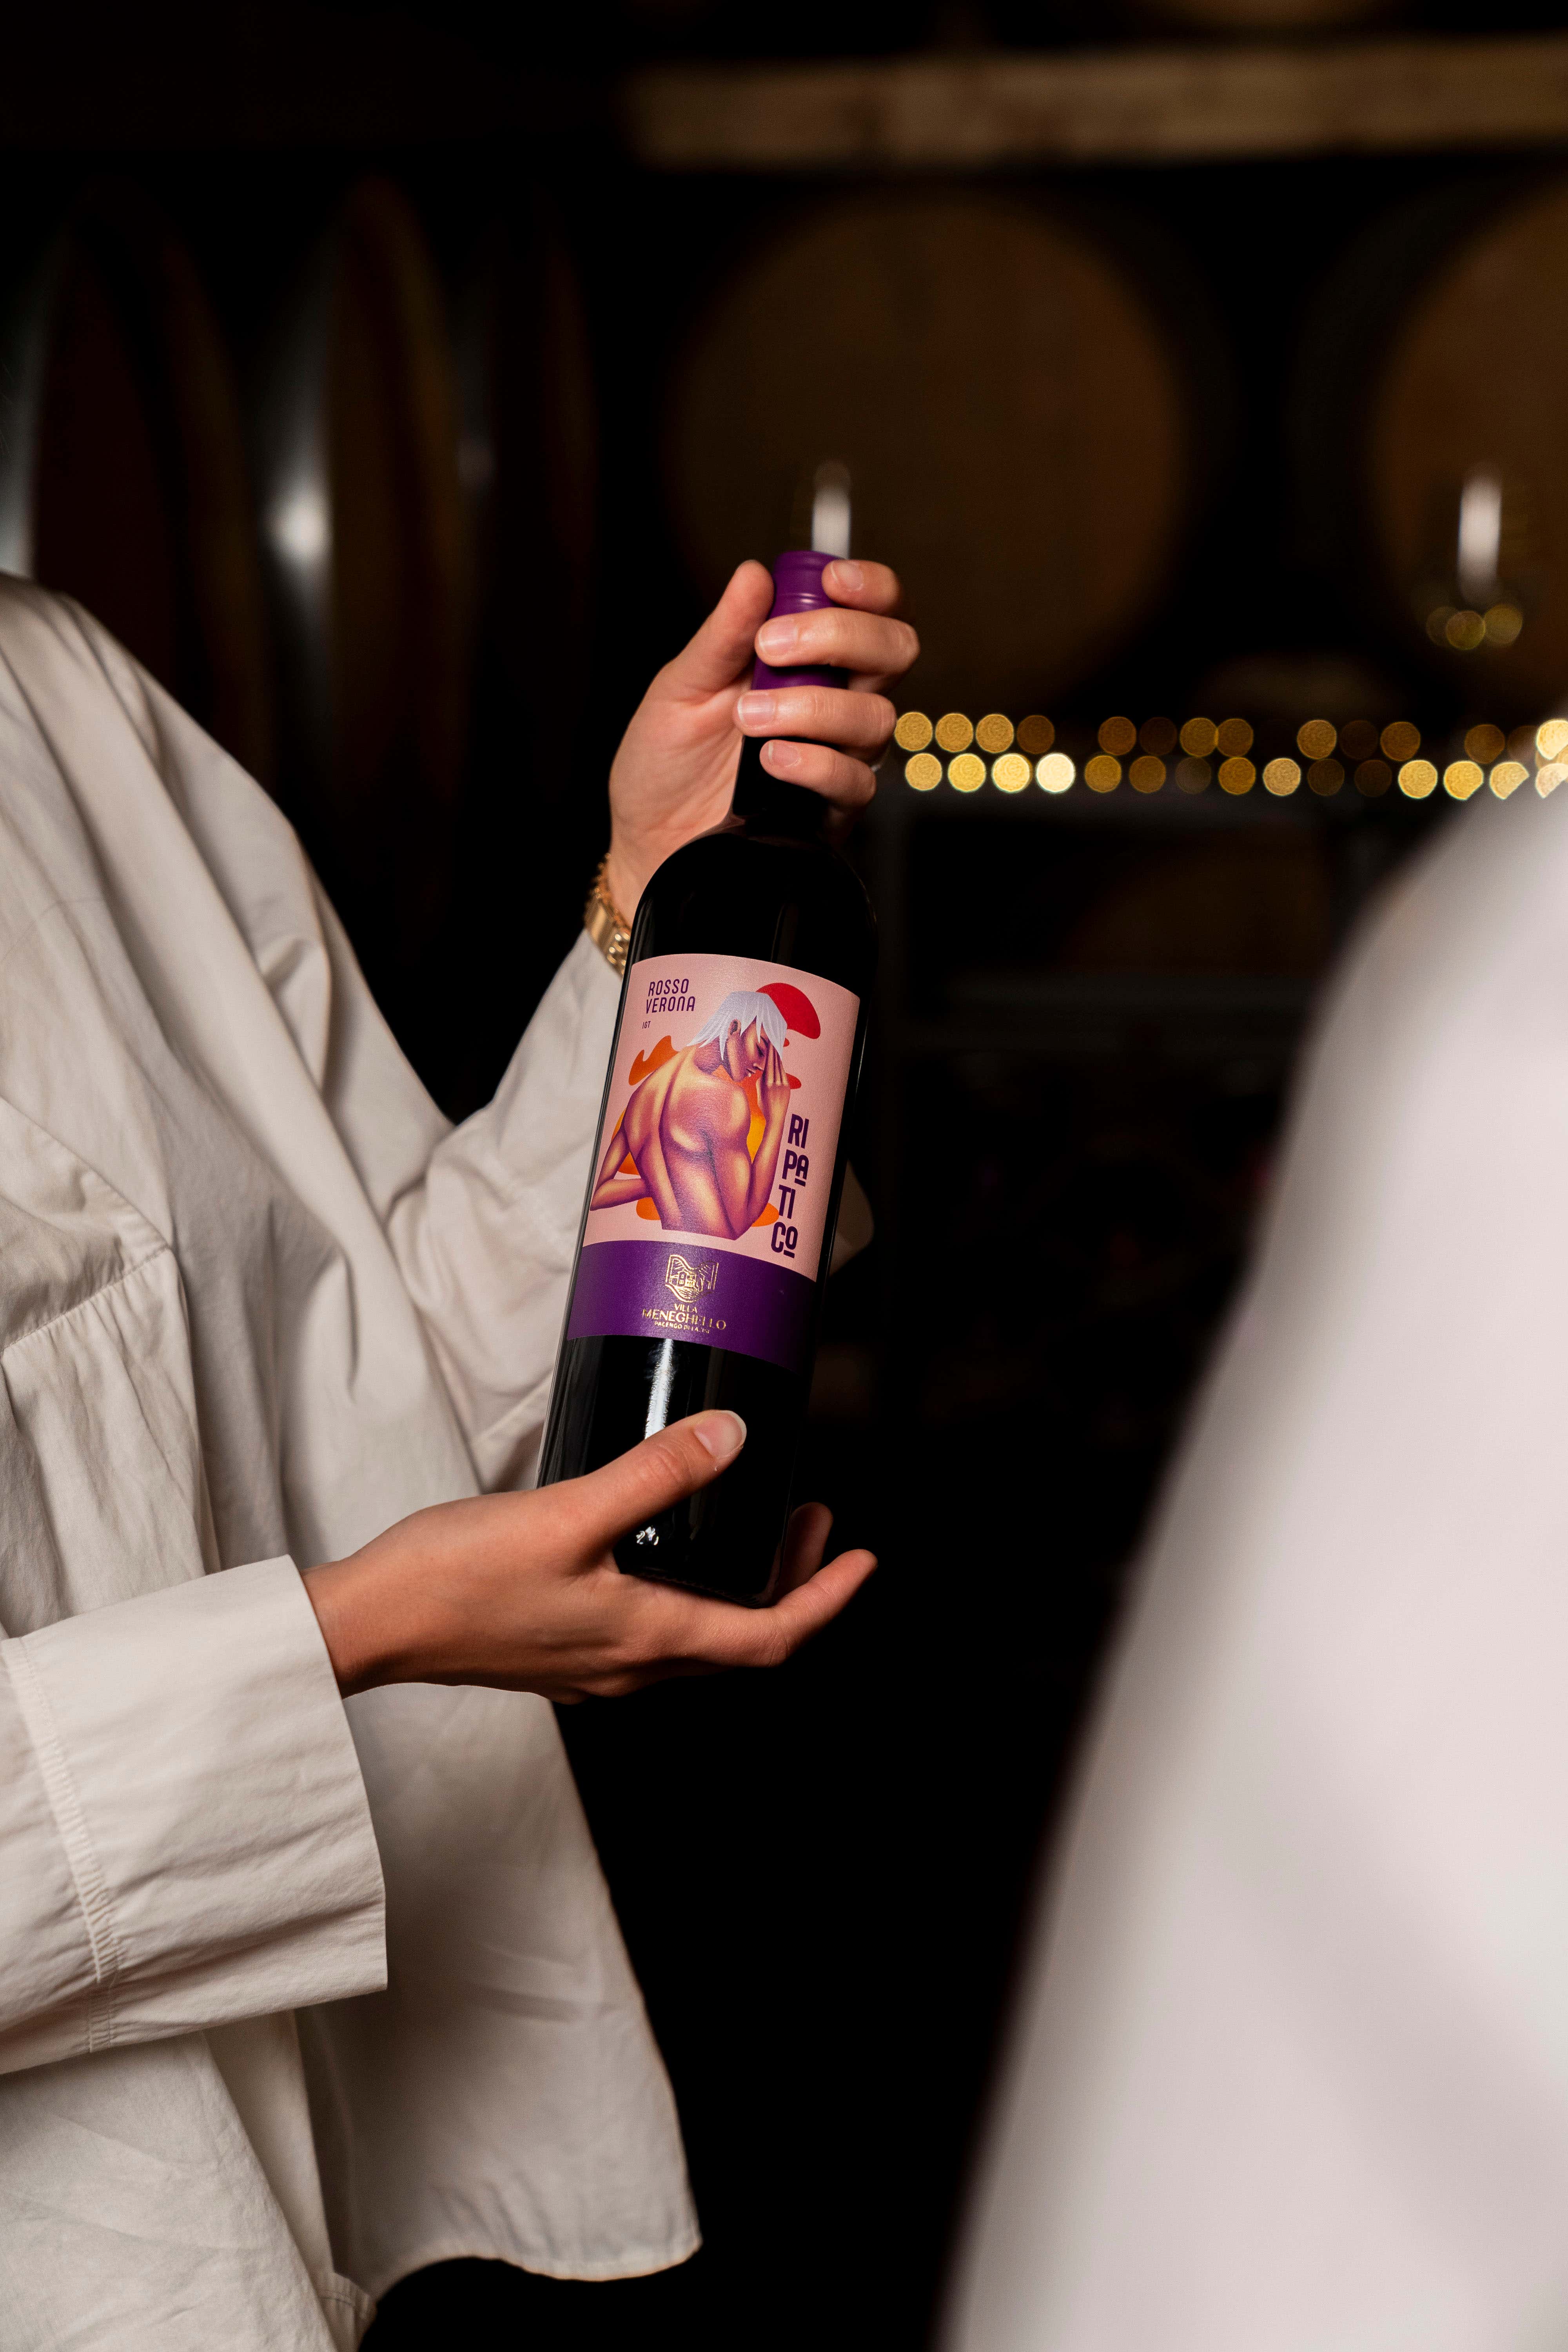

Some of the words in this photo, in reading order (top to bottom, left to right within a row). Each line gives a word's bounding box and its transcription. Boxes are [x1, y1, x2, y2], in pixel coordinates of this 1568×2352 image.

[648, 978, 689, 996] ROSSO
[646, 996, 695, 1014] VERONA
[642, 1021, 651, 1029] IGT
[788, 1113, 809, 1149] RI
[782, 1149, 809, 1187] PA
[779, 1184, 796, 1219] TI
[674, 1303, 697, 1313] VILLA
[654, 1321, 682, 1329] PACENGO
